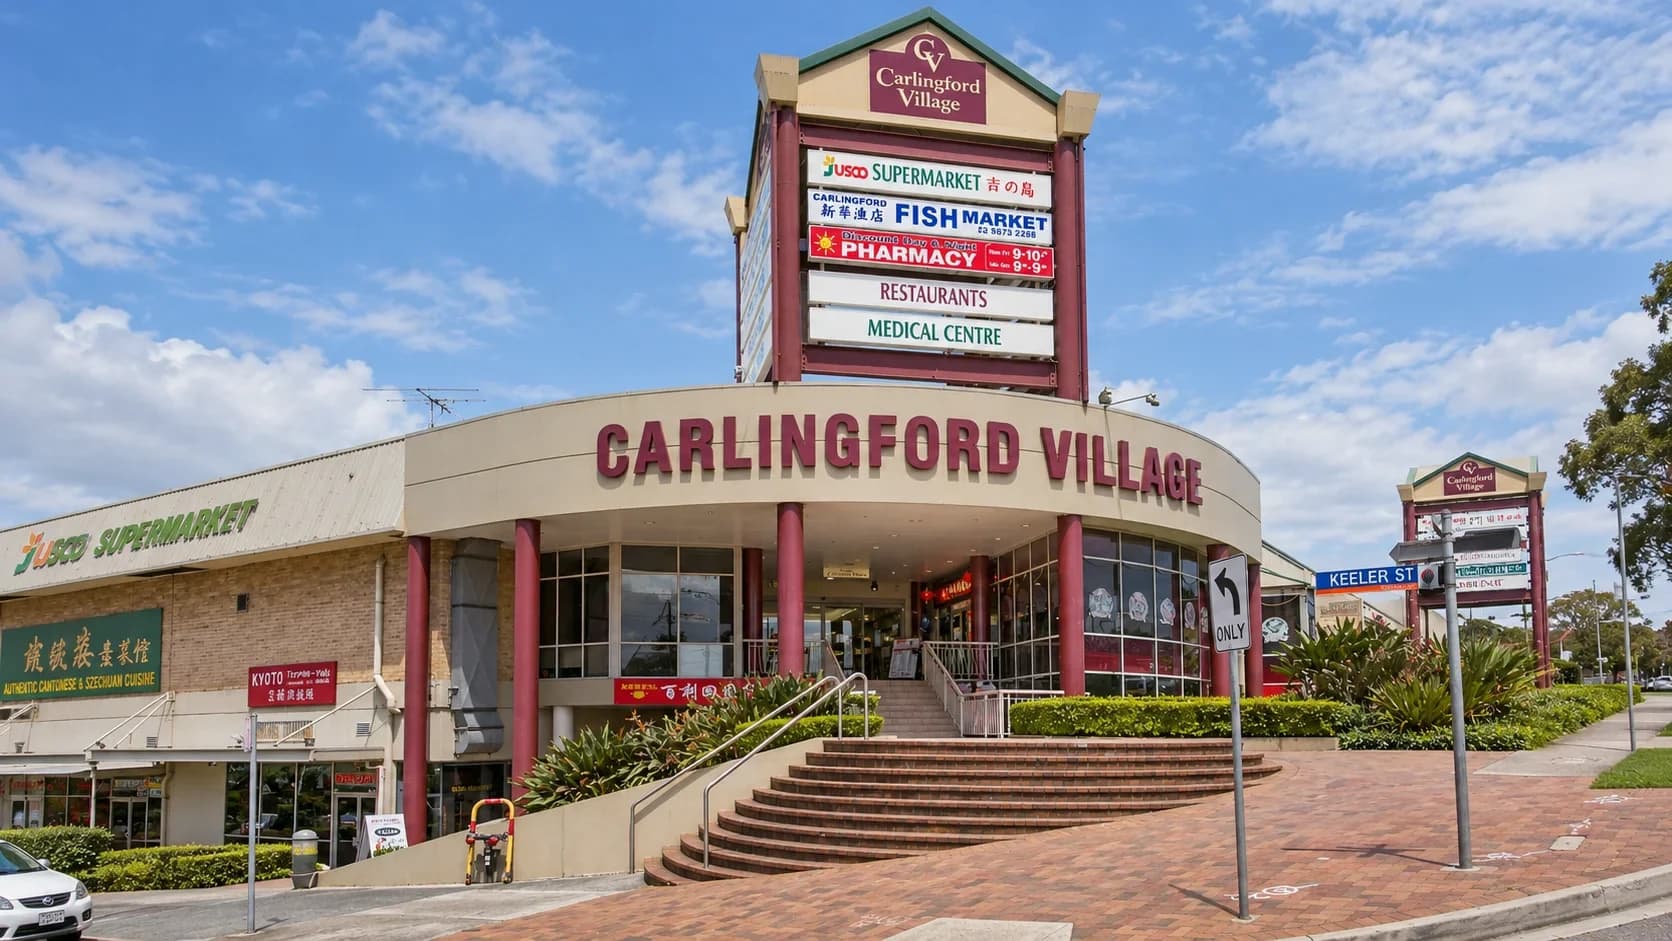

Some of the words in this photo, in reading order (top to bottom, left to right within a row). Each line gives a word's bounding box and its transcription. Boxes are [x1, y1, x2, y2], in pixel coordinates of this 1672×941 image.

[913, 38, 945, 72] CV
[876, 67, 980, 94] Carlingford
[896, 88, 960, 114] Village
[872, 163, 981, 191] SUPERMARKET
[813, 193, 887, 207] CARLINGFORD
[895, 203, 958, 229] FISH
[962, 210, 1047, 231] MARKET
[841, 241, 977, 267] PHARMACY
[880, 282, 988, 308] RESTAURANTS
[867, 319, 939, 341] MEDICAL
[943, 324, 1002, 346] CENTRE
[596, 412, 1020, 479] CARLINGFORD
[1039, 427, 1204, 506] VILLAGE
[93, 498, 259, 559] SUPERMARKET
[1330, 569, 1388, 587] KEELER
[1395, 567, 1413, 582] ST
[1217, 622, 1246, 642] ONLY
[252, 671, 284, 687] KYOTO
